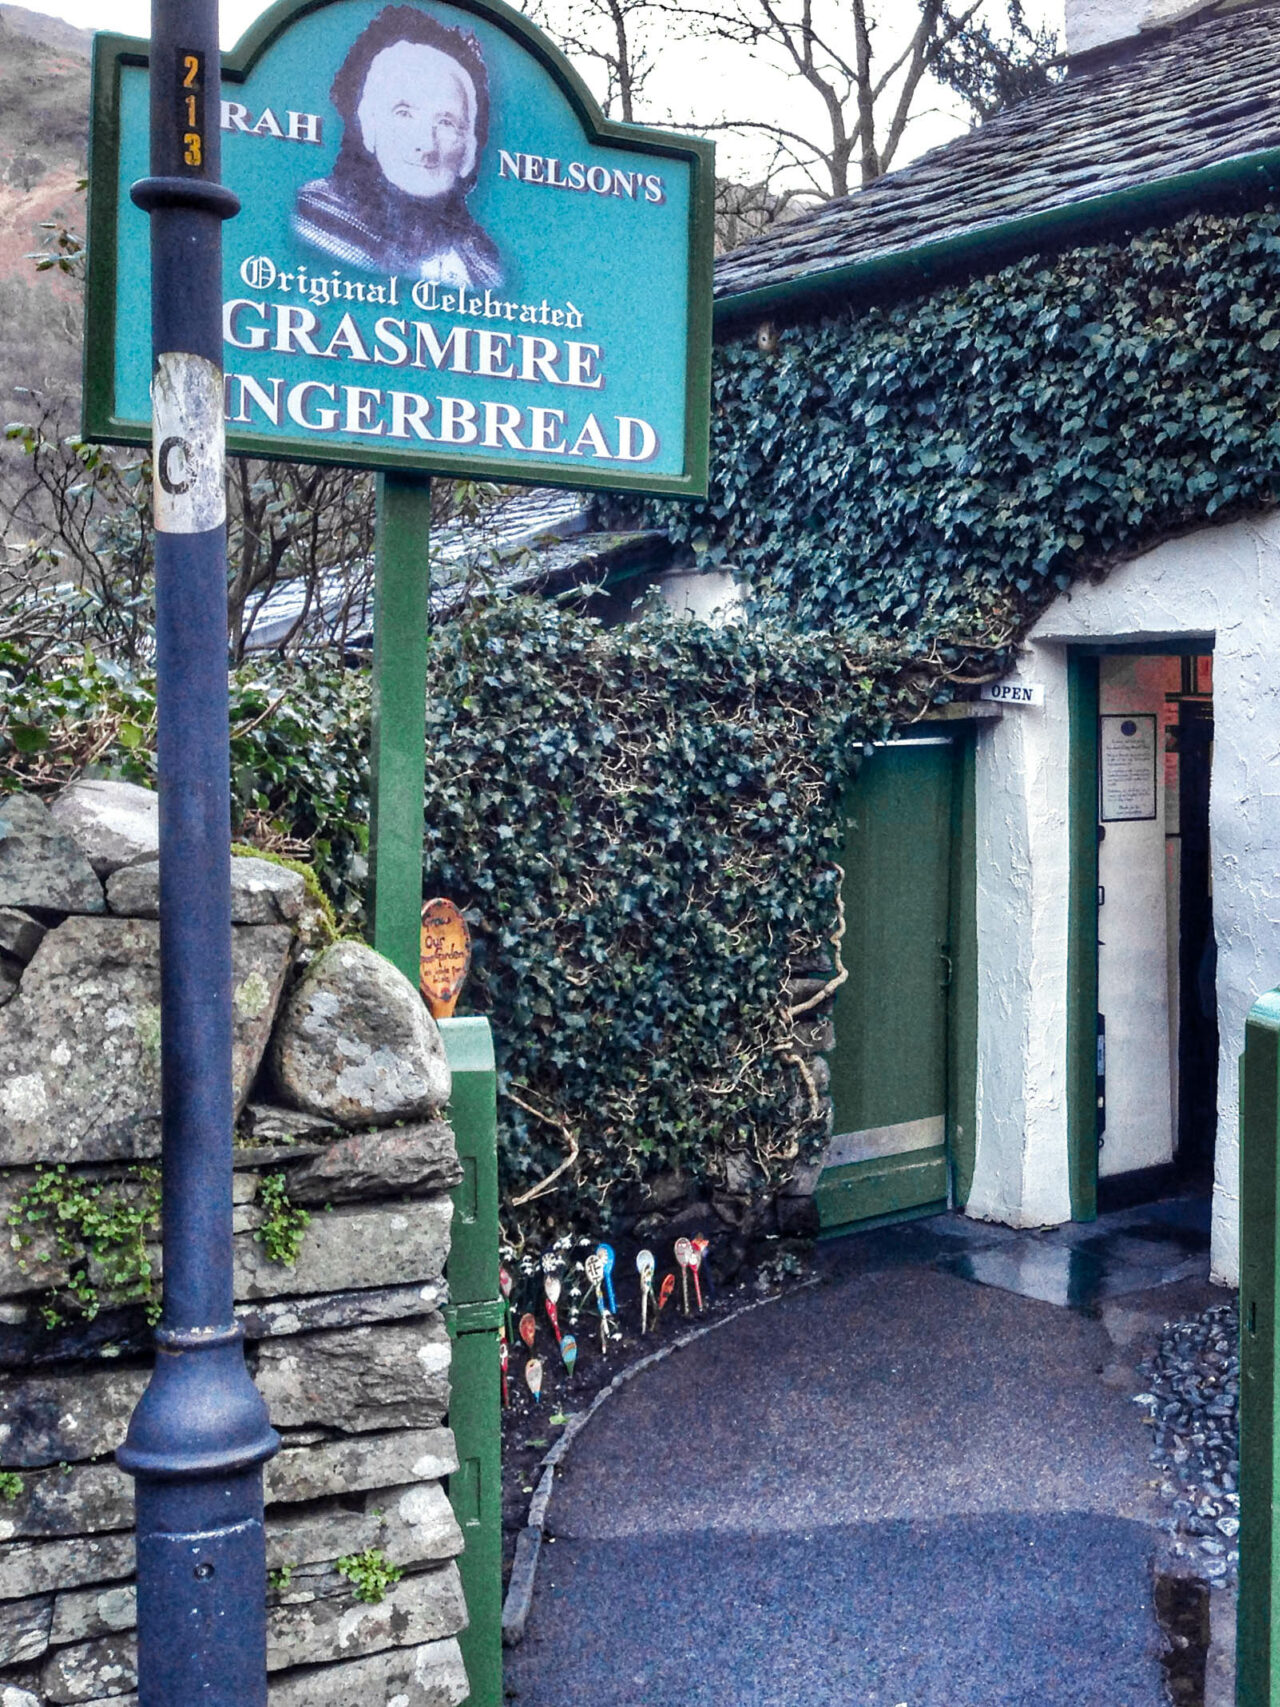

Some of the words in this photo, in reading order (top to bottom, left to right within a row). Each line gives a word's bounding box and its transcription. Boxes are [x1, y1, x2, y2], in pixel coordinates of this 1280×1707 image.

[220, 100, 322, 143] RAH
[499, 149, 663, 202] NELSON'S
[240, 255, 399, 305] Original
[411, 280, 585, 329] Celebrated
[222, 298, 602, 389] GRASMERE
[224, 373, 658, 461] NGERBREAD
[991, 684, 1034, 702] OPEN
